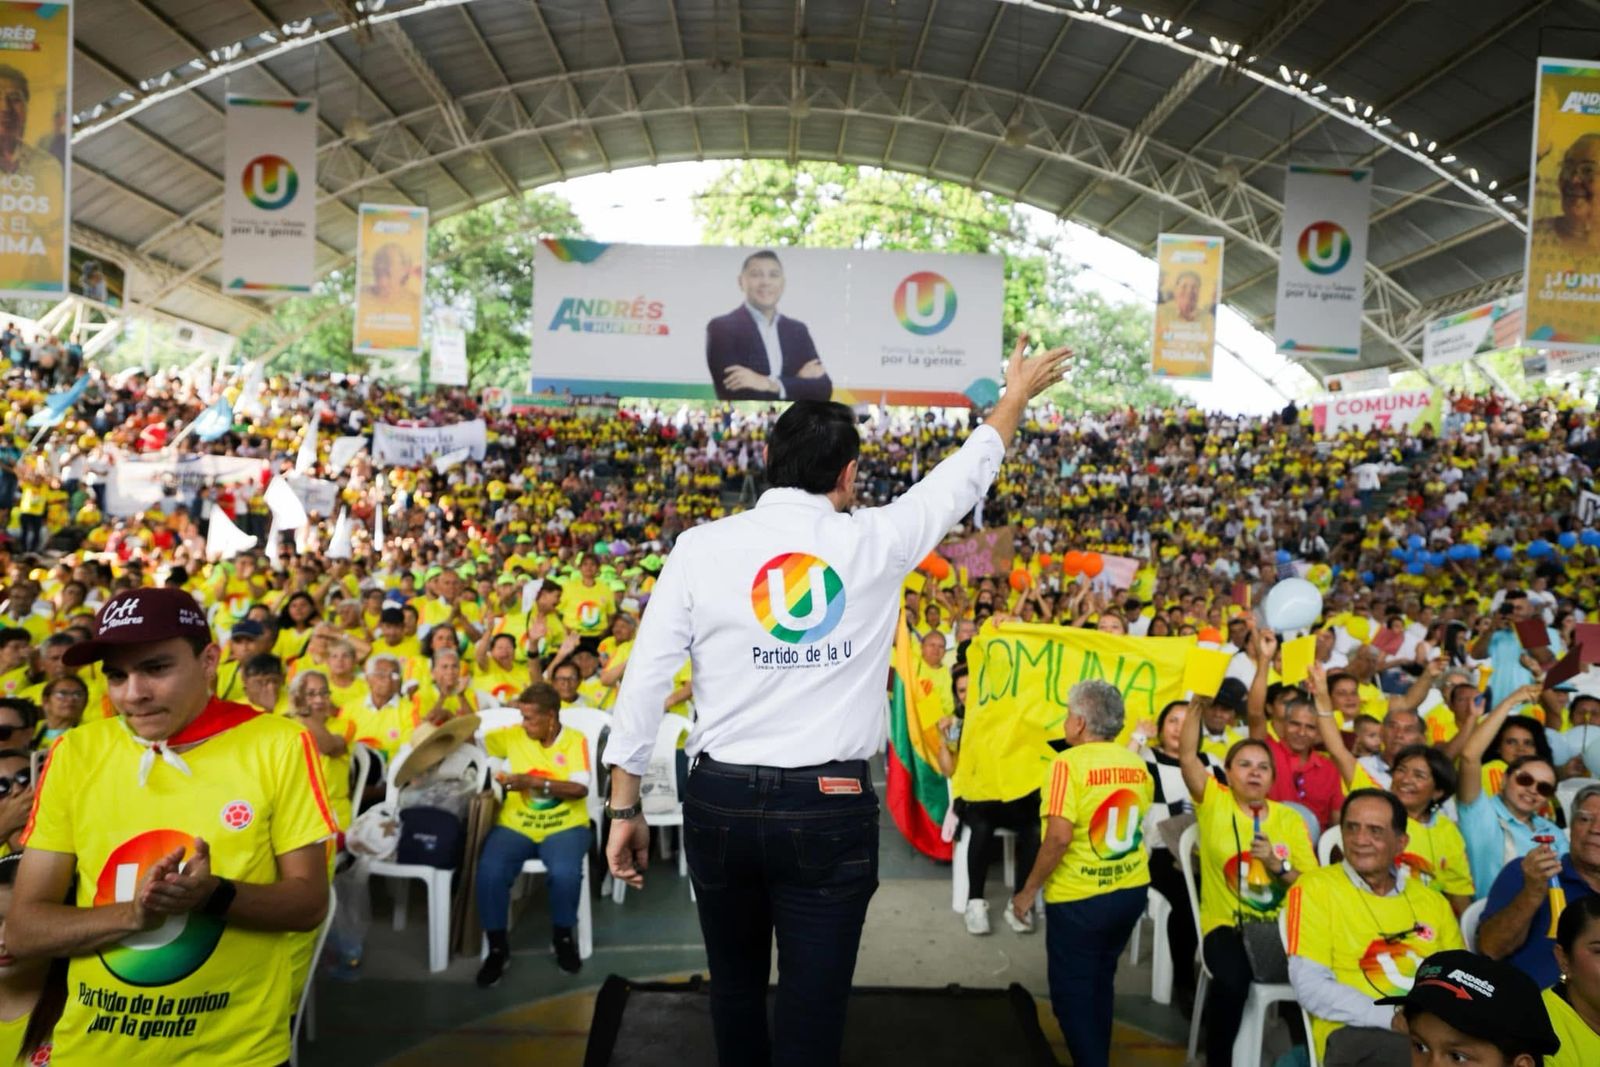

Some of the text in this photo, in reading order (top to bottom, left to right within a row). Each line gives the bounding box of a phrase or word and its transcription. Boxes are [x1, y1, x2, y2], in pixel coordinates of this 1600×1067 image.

[548, 296, 664, 332] ANDRÉS
[1335, 392, 1430, 415] COMUNA
[767, 565, 828, 631] U
[752, 640, 852, 664] Partido de la U
[1105, 805, 1139, 852] U
[1447, 969, 1496, 993] ANDRÉS
[78, 982, 230, 1016] Partido de la union
[87, 1012, 197, 1041] por la gente
